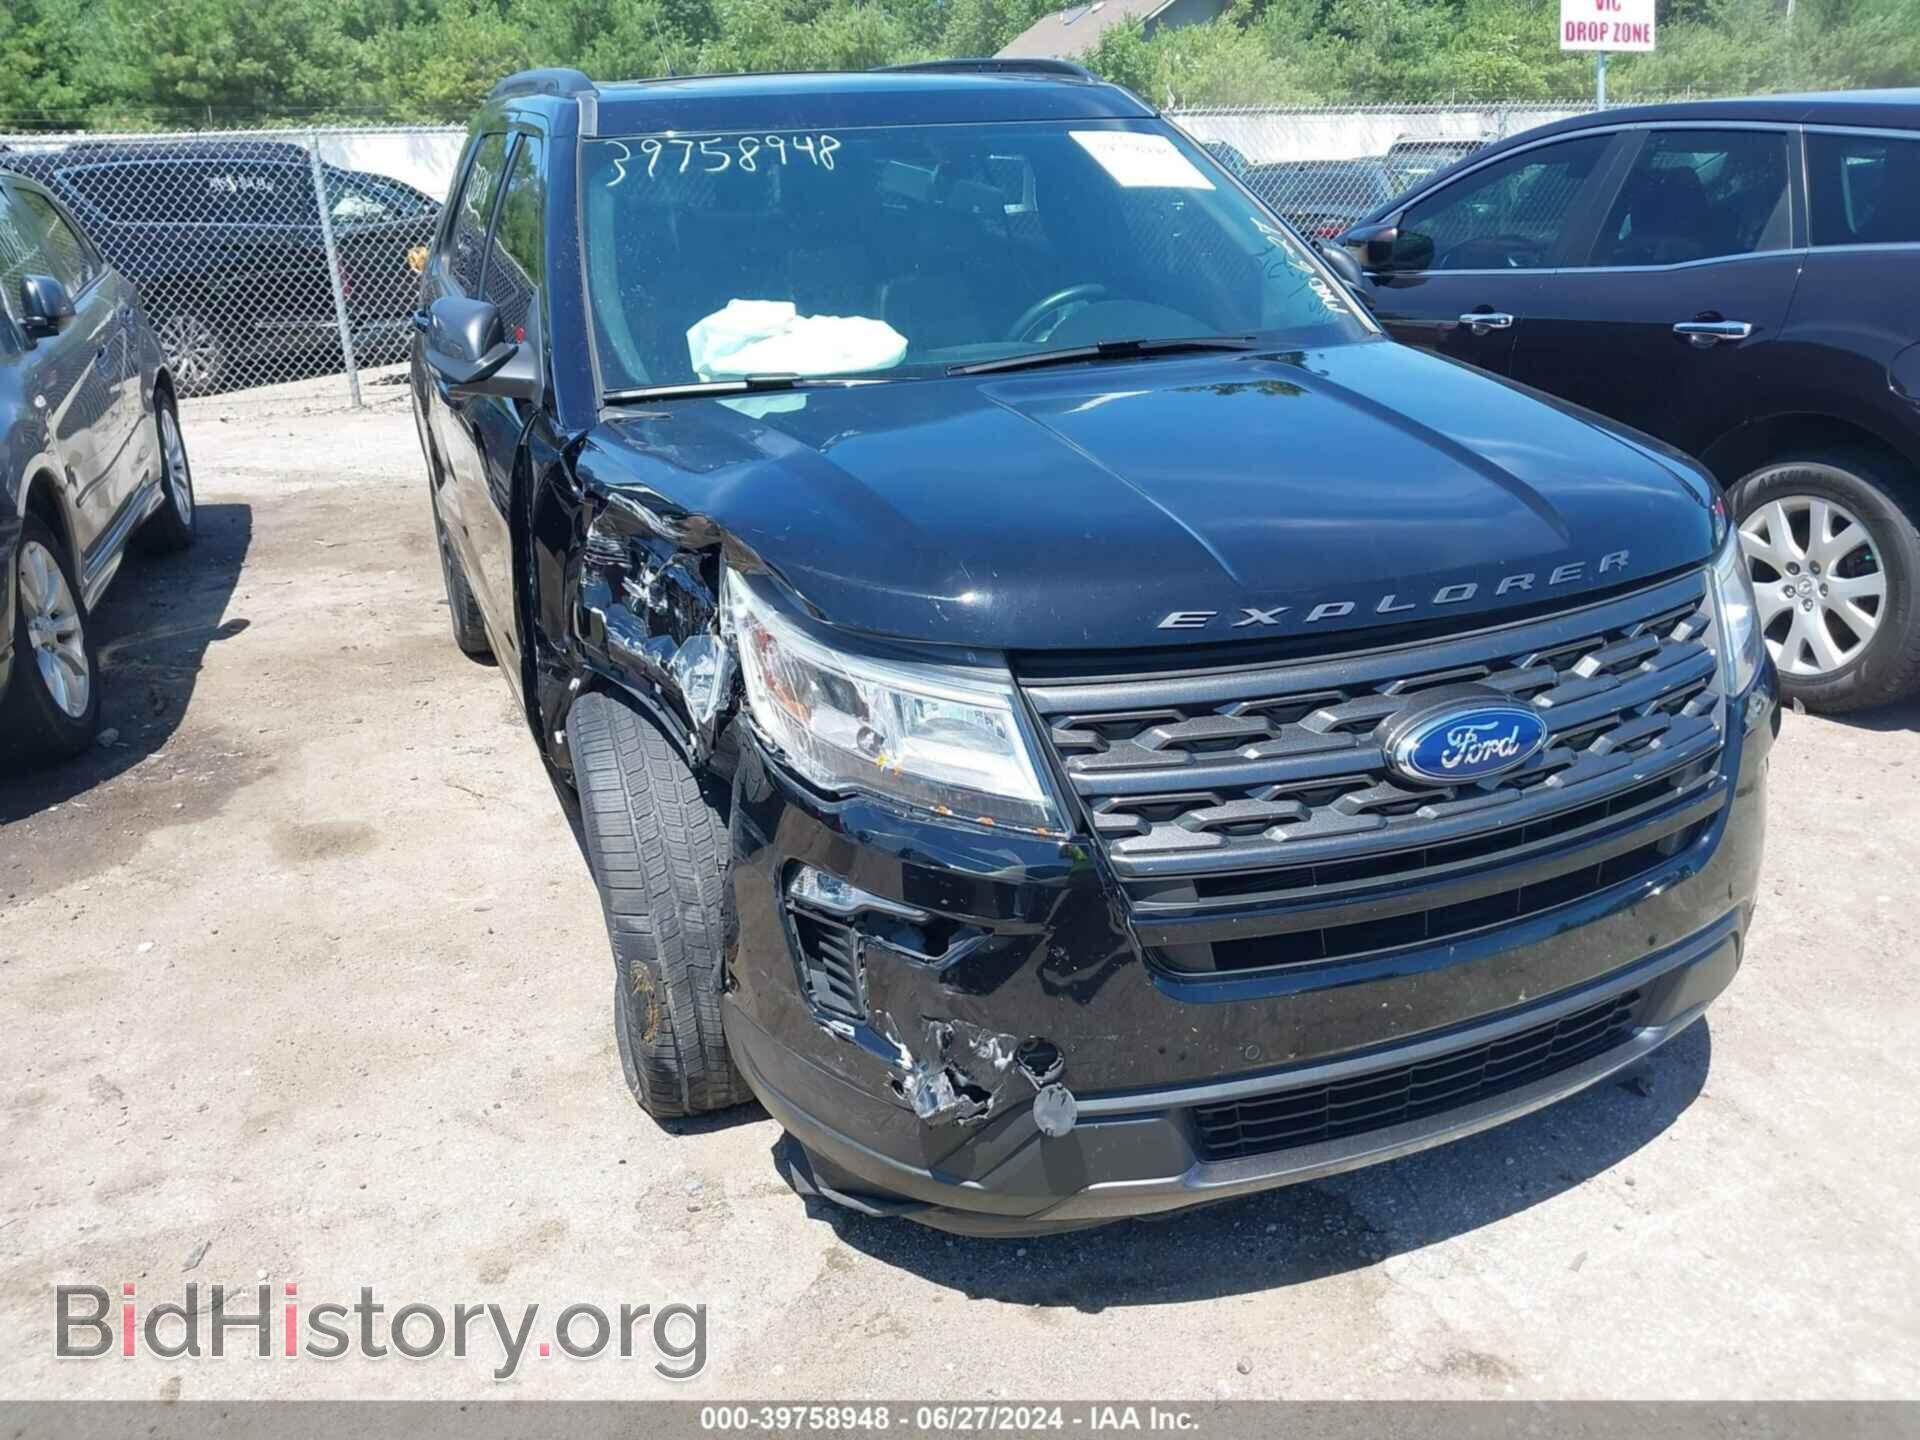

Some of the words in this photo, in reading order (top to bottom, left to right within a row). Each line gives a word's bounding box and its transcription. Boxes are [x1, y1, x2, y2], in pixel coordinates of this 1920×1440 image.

[1565, 21, 1609, 42] DROP
[1613, 22, 1651, 43] ZONE
[603, 134, 842, 187] 39758948
[1157, 550, 1630, 629] EXPLORER
[1441, 721, 1521, 769] Ford
